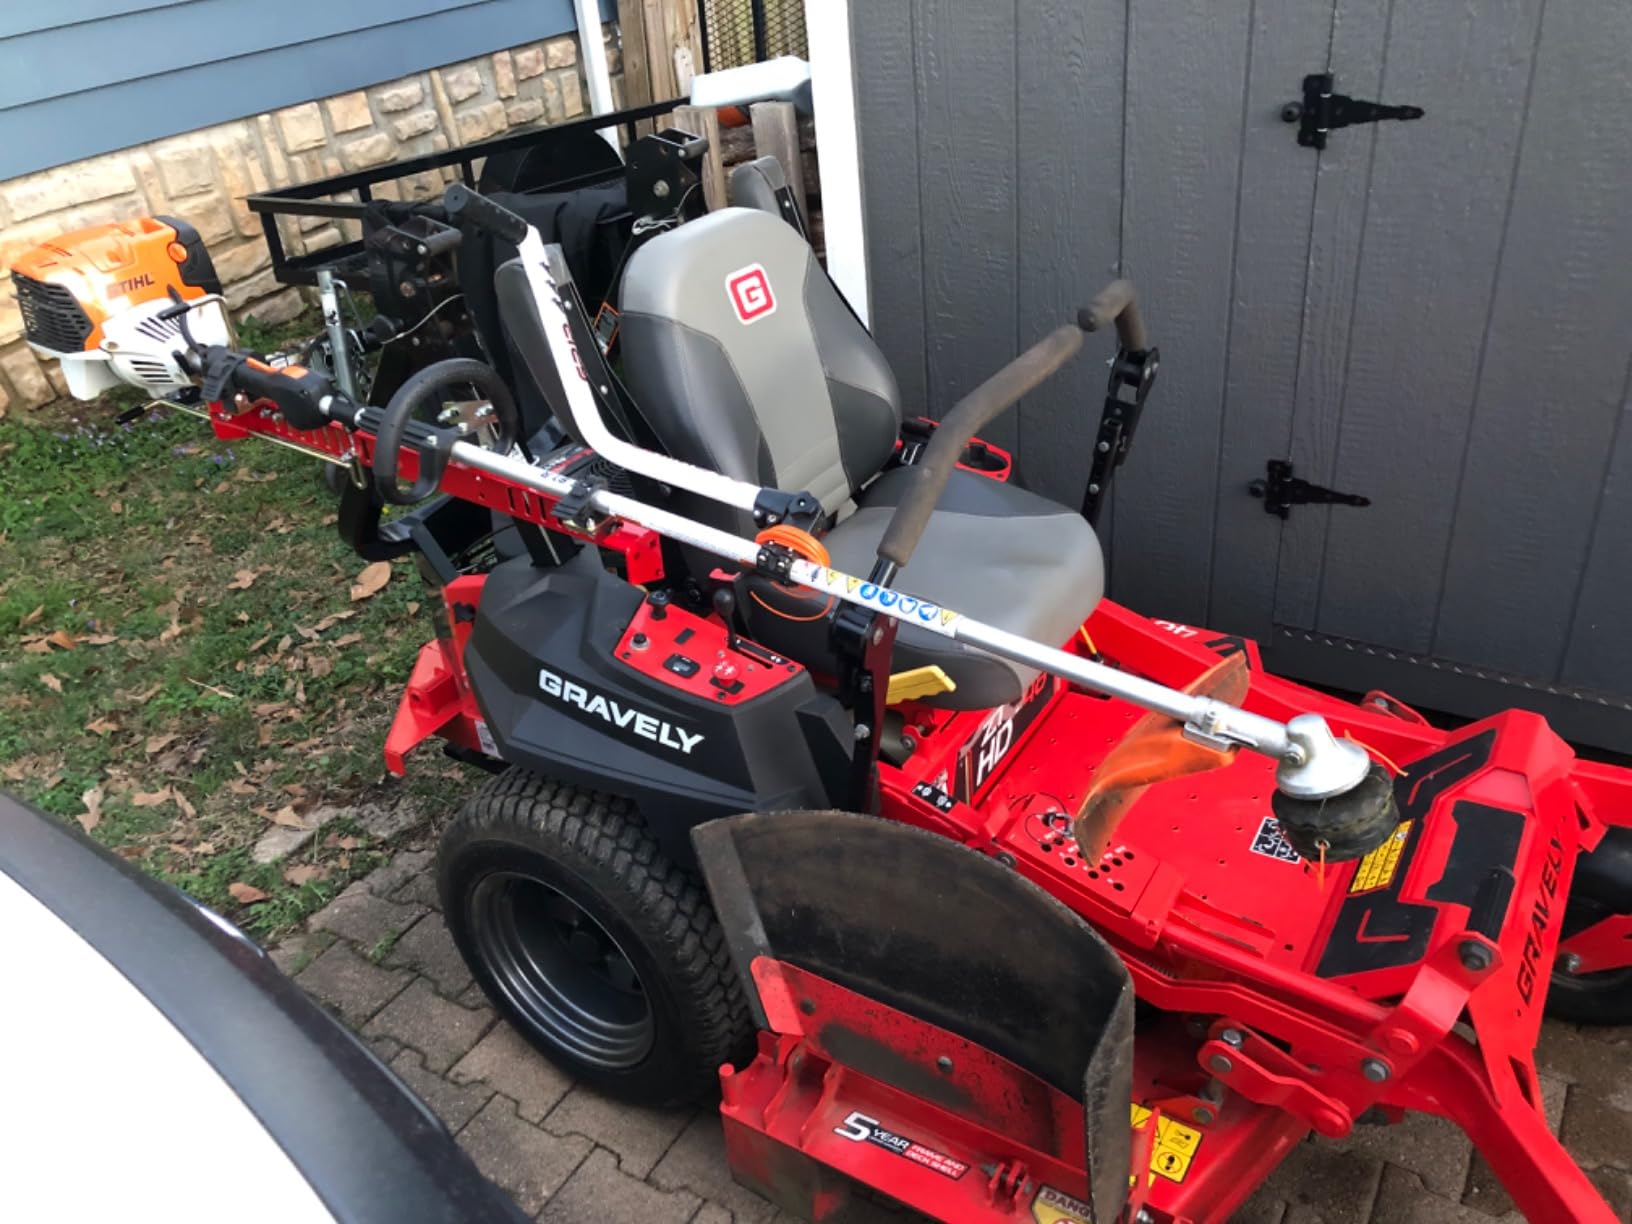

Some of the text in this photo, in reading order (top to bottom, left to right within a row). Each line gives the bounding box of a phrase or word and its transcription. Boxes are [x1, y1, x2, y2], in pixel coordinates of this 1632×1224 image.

[107, 273, 155, 300] TIHL
[538, 669, 704, 753] GRAVELY
[976, 717, 1013, 786] HD
[1516, 824, 1564, 1006] GRAVELY
[833, 1111, 880, 1141] 5
[872, 1128, 910, 1150] YEAR
[1042, 1191, 1091, 1219] DANG
